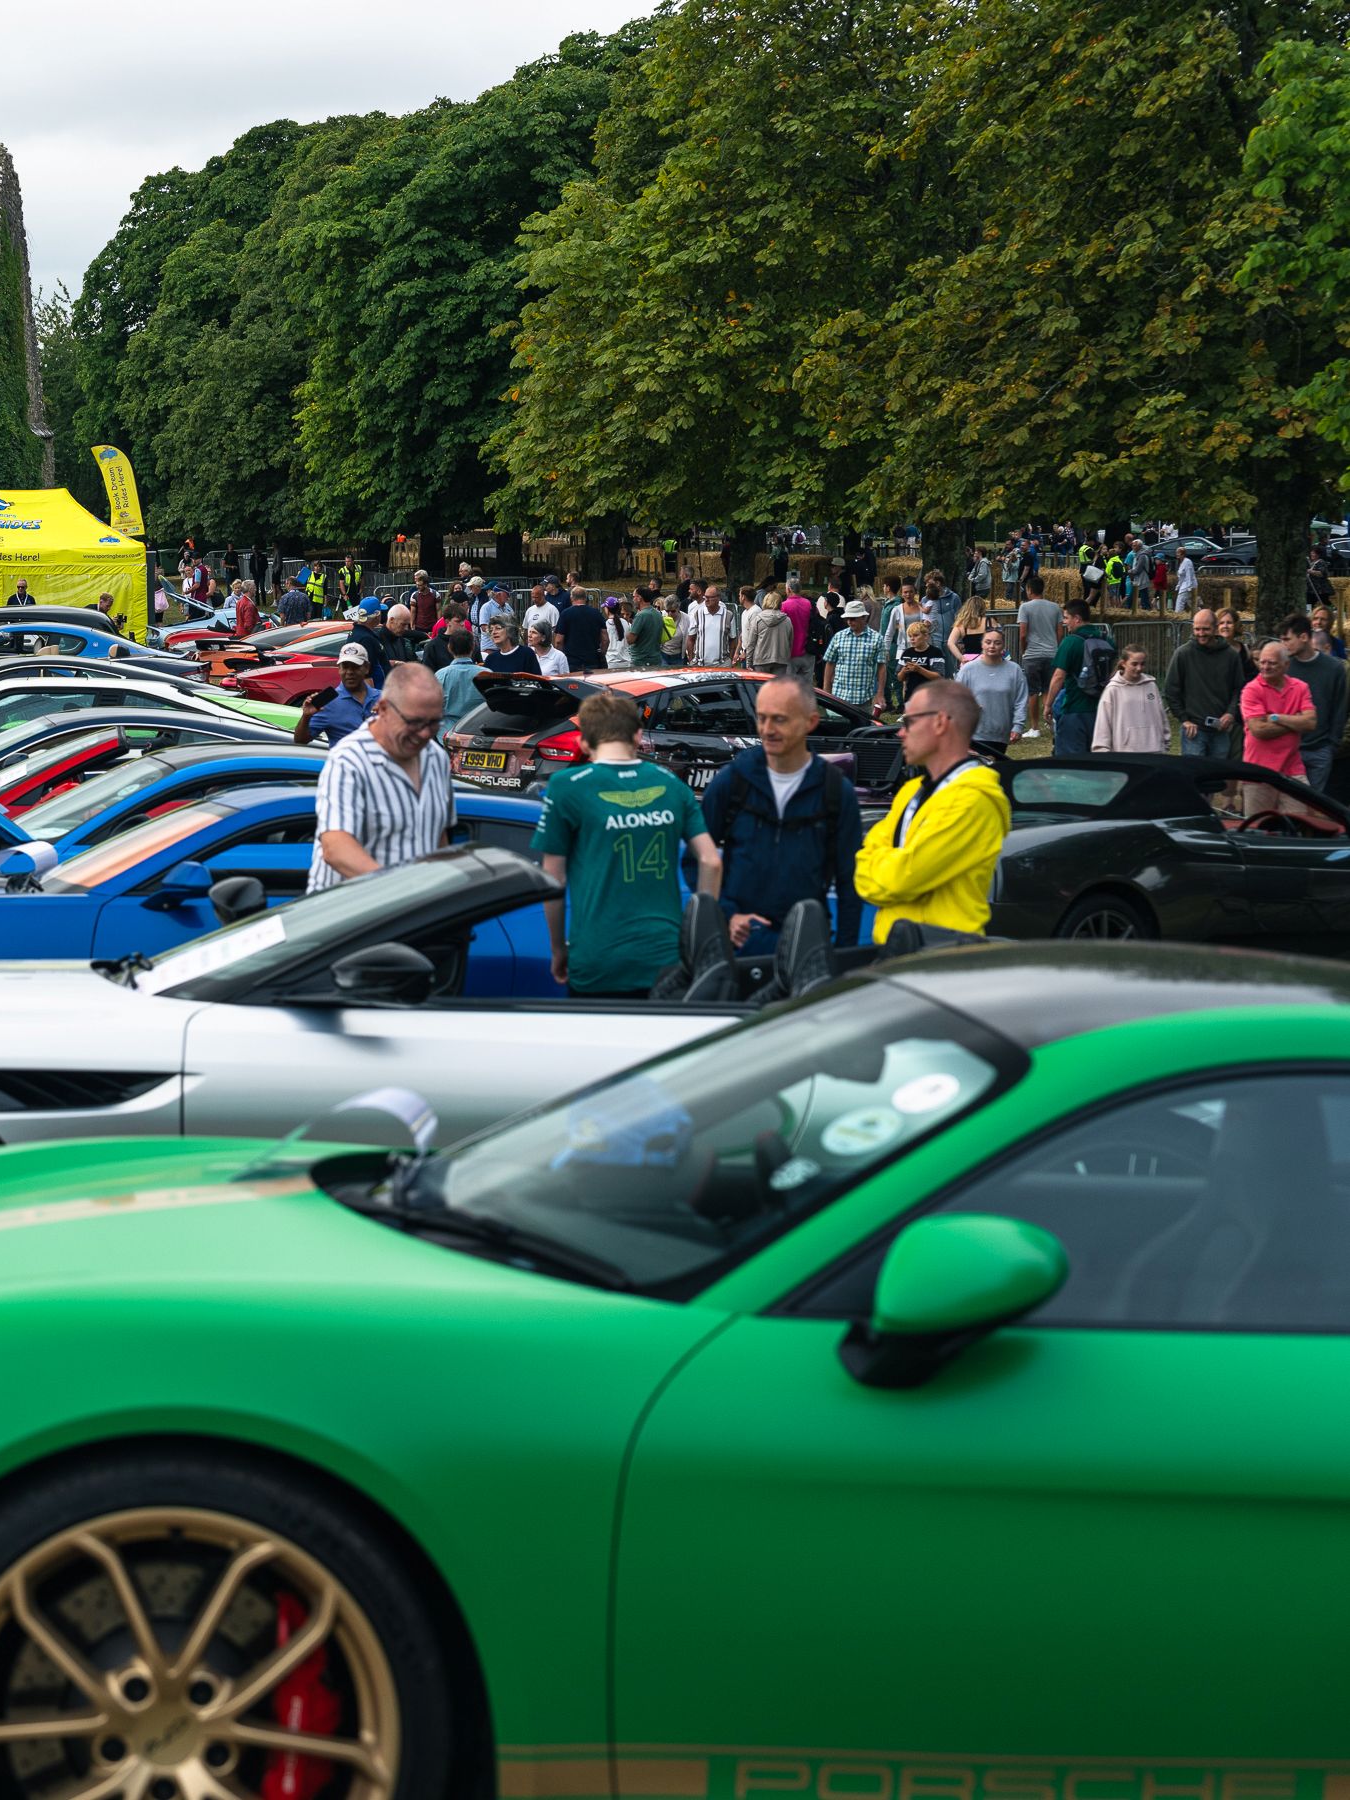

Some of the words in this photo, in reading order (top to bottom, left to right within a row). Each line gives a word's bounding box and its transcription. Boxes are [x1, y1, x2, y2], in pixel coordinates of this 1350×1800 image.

[109, 467, 117, 491] Dream
[116, 465, 125, 488] Here!
[112, 492, 121, 510] Book
[121, 488, 129, 508] Rides
[15, 552, 40, 561] Here!
[82, 552, 142, 560] www.sportingbears.co.uk
[911, 656, 928, 664] EA7
[605, 810, 675, 830] ALONSO
[613, 831, 669, 883] 14
